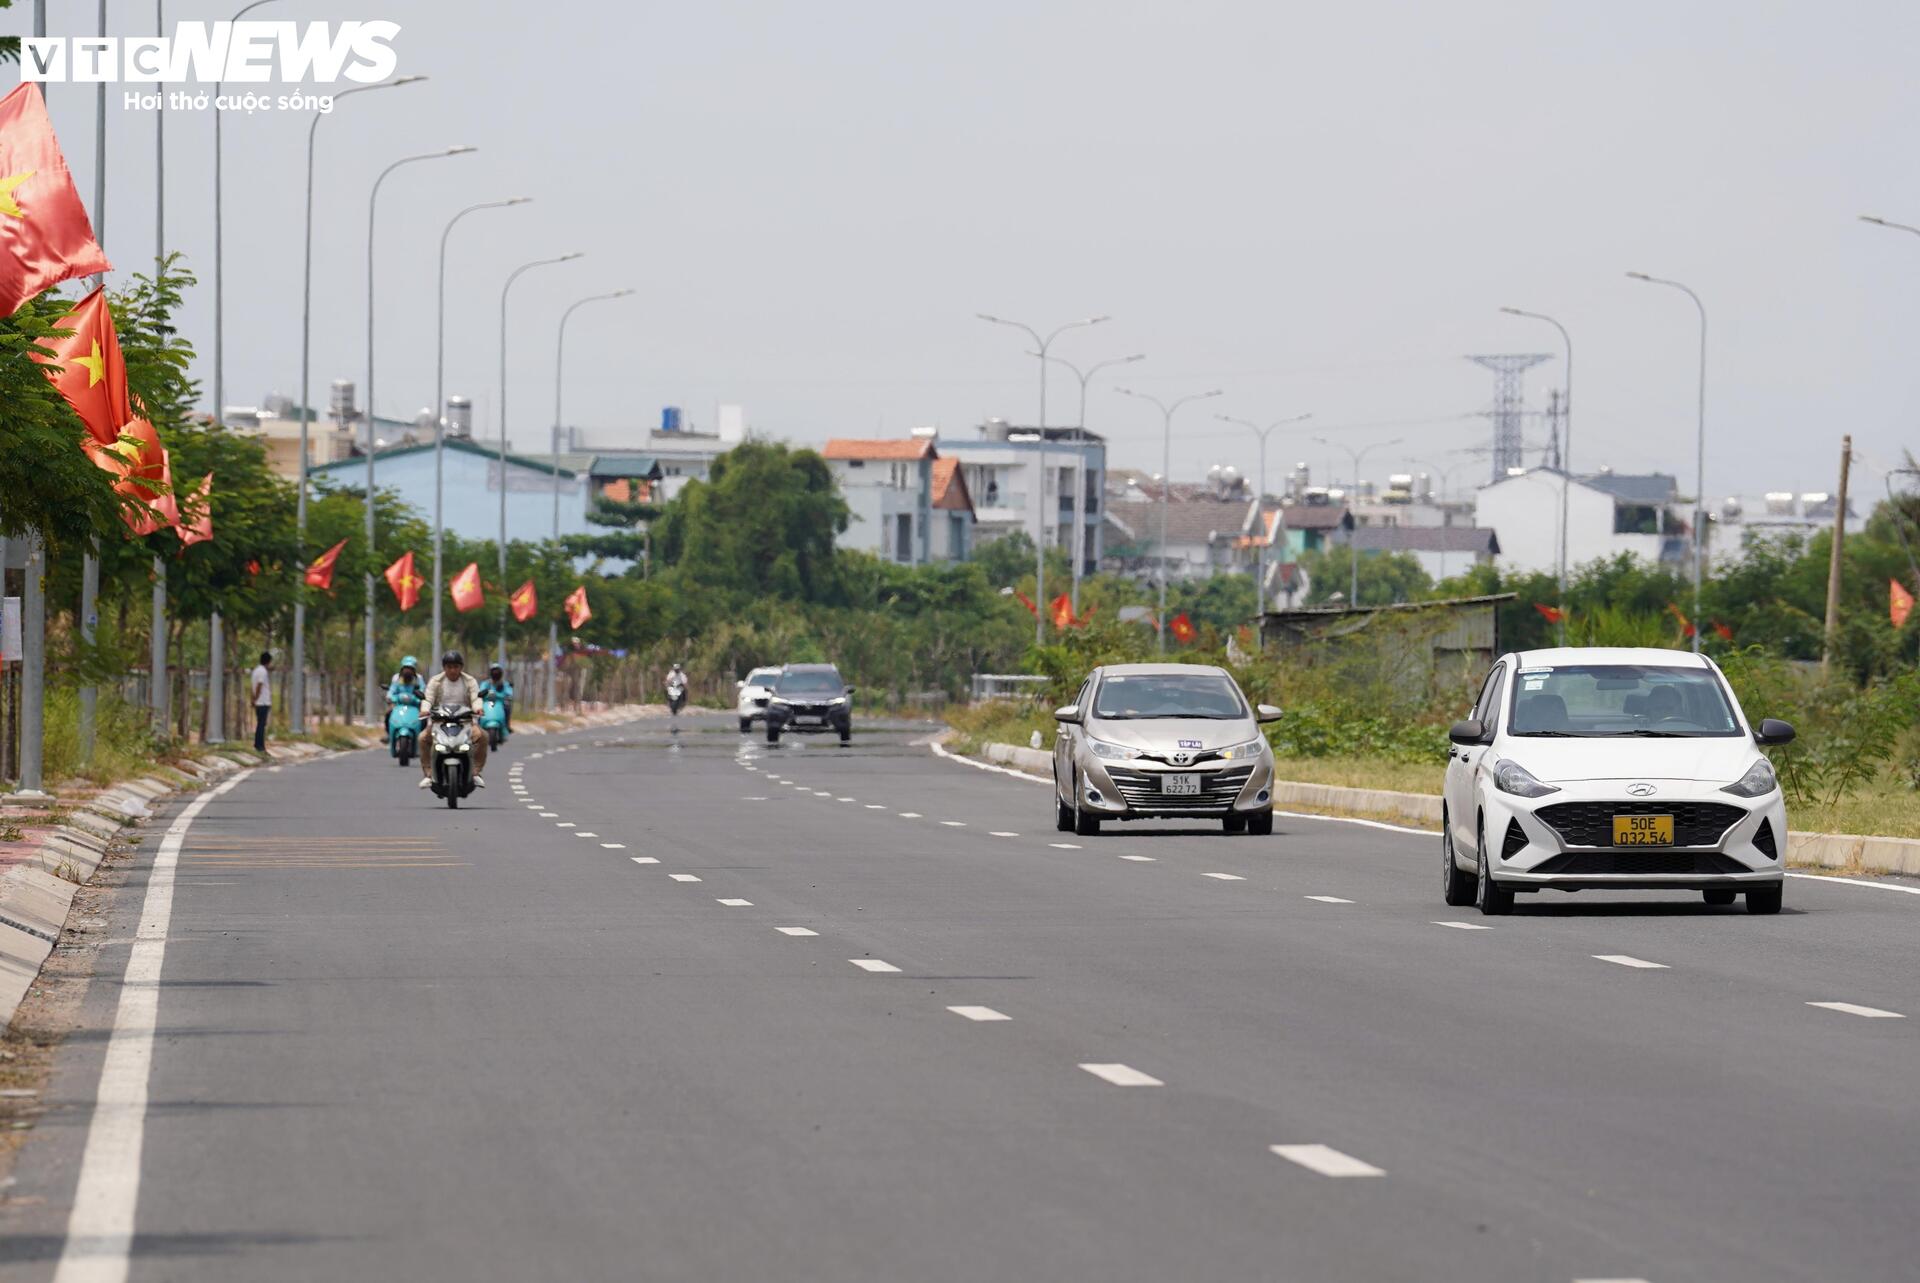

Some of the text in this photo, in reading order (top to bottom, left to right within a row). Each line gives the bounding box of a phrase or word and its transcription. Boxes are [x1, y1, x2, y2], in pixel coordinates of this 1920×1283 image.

[1173, 776, 1189, 784] 51K
[1631, 818, 1656, 830] 50E
[1620, 832, 1667, 844] 032.54
